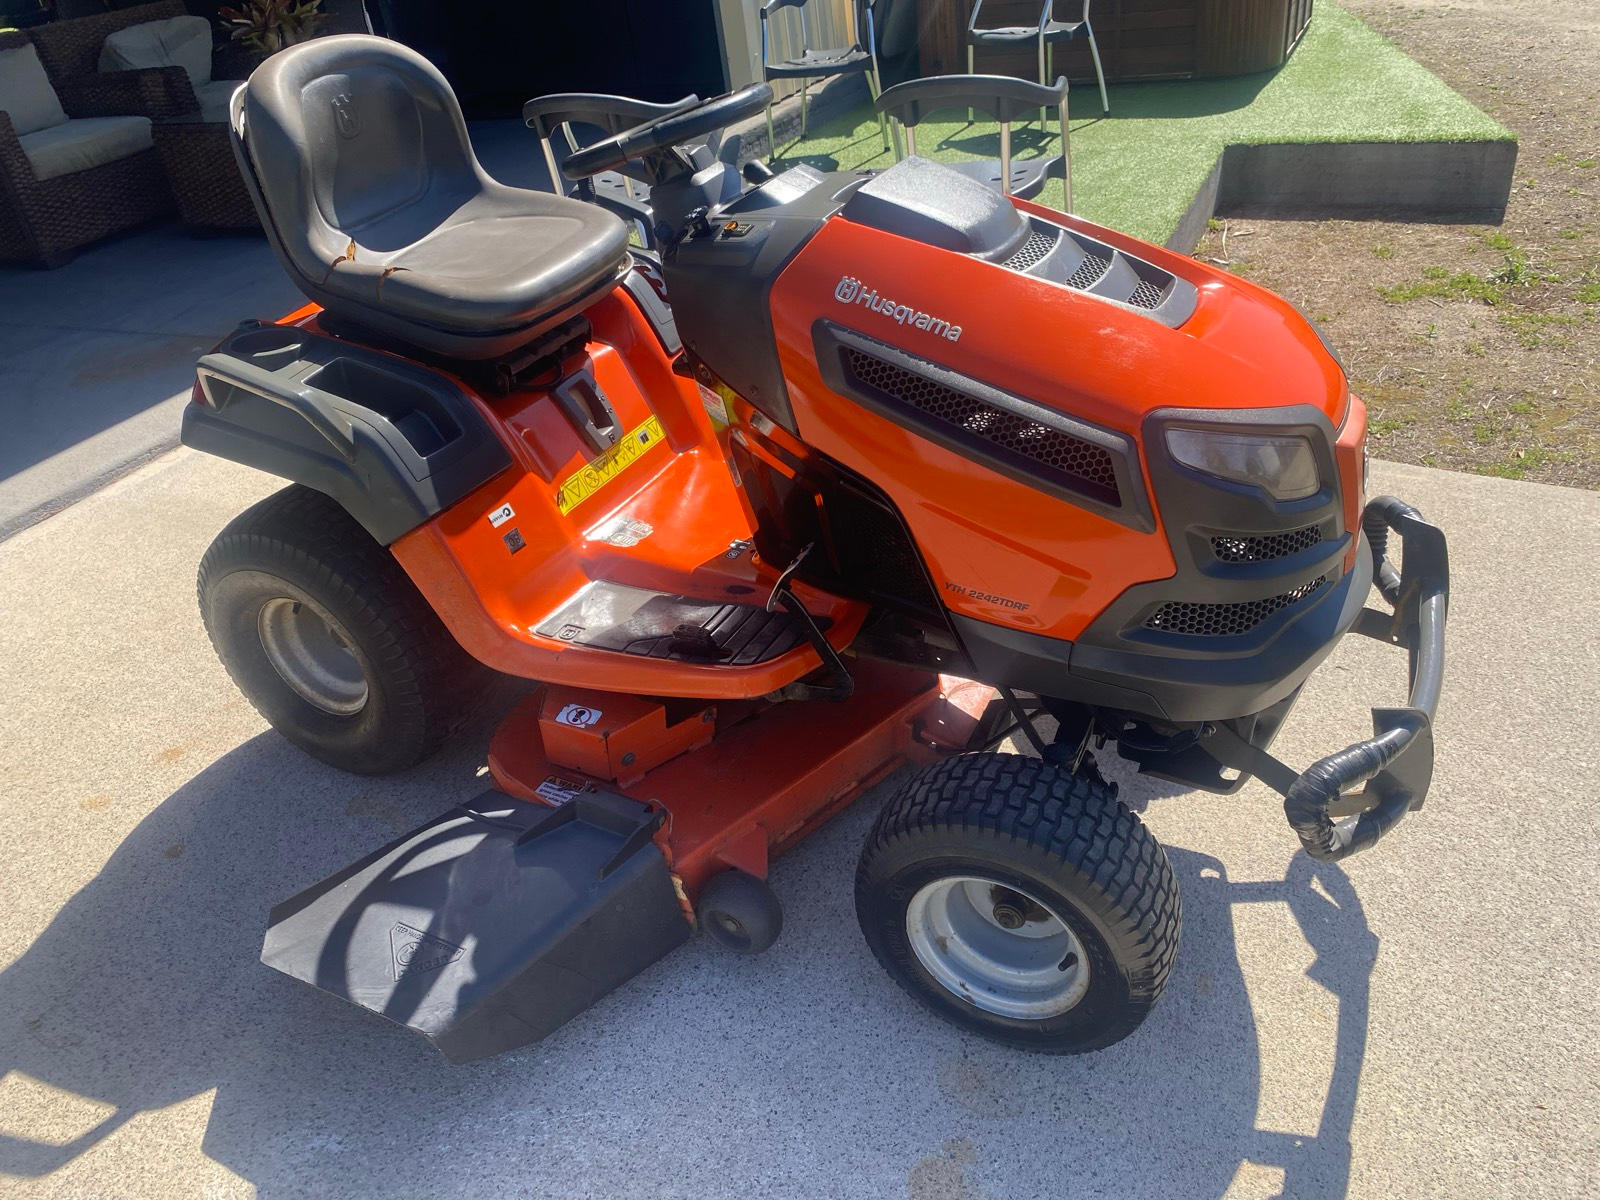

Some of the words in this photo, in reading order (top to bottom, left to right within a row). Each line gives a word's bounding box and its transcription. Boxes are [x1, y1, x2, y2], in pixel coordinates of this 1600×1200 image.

[855, 286, 963, 342] Husqvarna
[944, 582, 967, 595] YTH
[968, 589, 1030, 612] 2242TDRF
